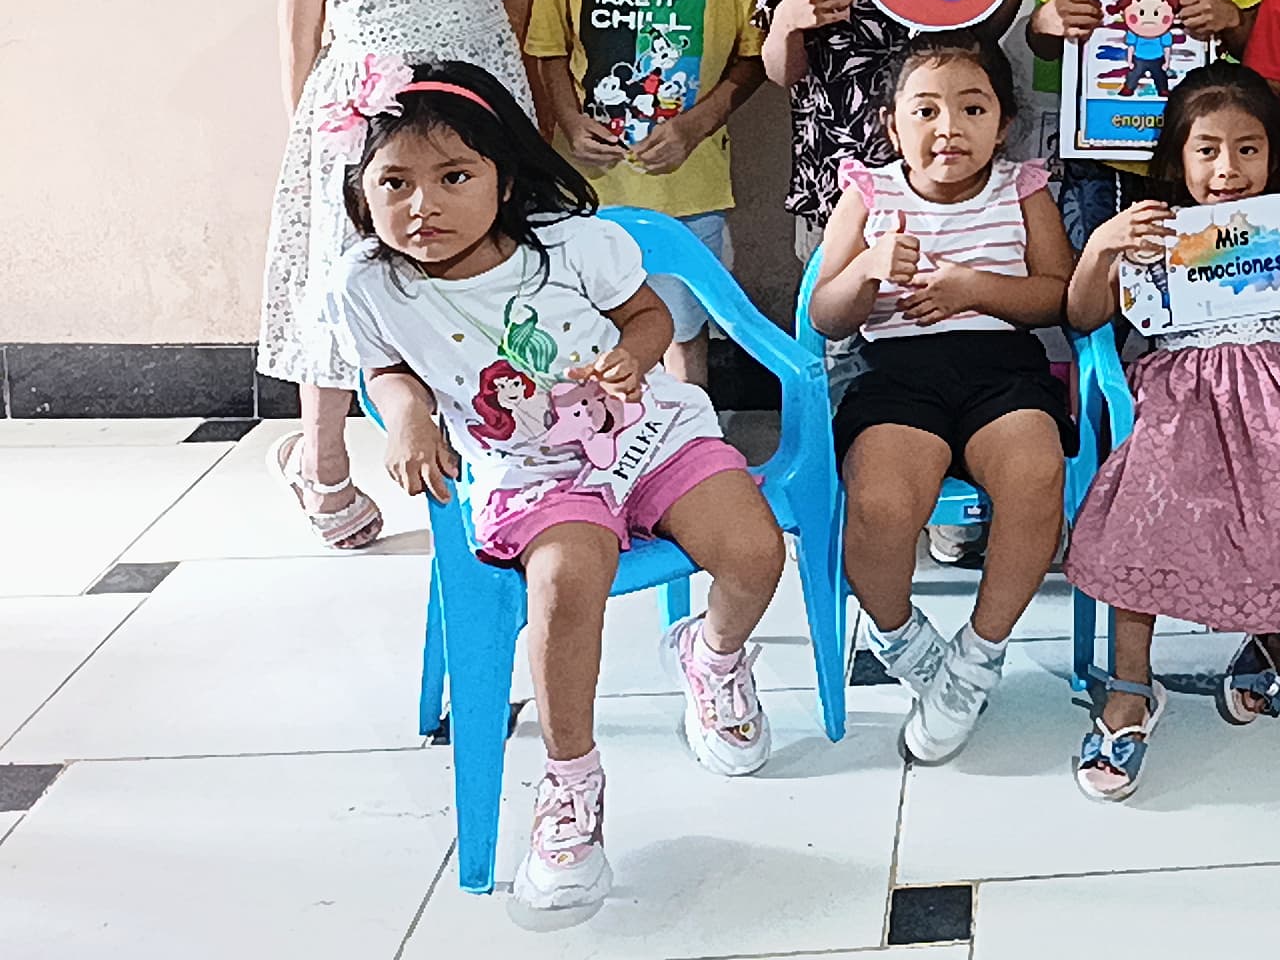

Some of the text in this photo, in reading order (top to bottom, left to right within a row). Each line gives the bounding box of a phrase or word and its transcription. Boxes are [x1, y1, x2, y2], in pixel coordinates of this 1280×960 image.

[591, 9, 692, 30] CHILL
[1112, 112, 1165, 129] enojad
[1215, 227, 1249, 250] Mis
[612, 419, 663, 481] MILKA
